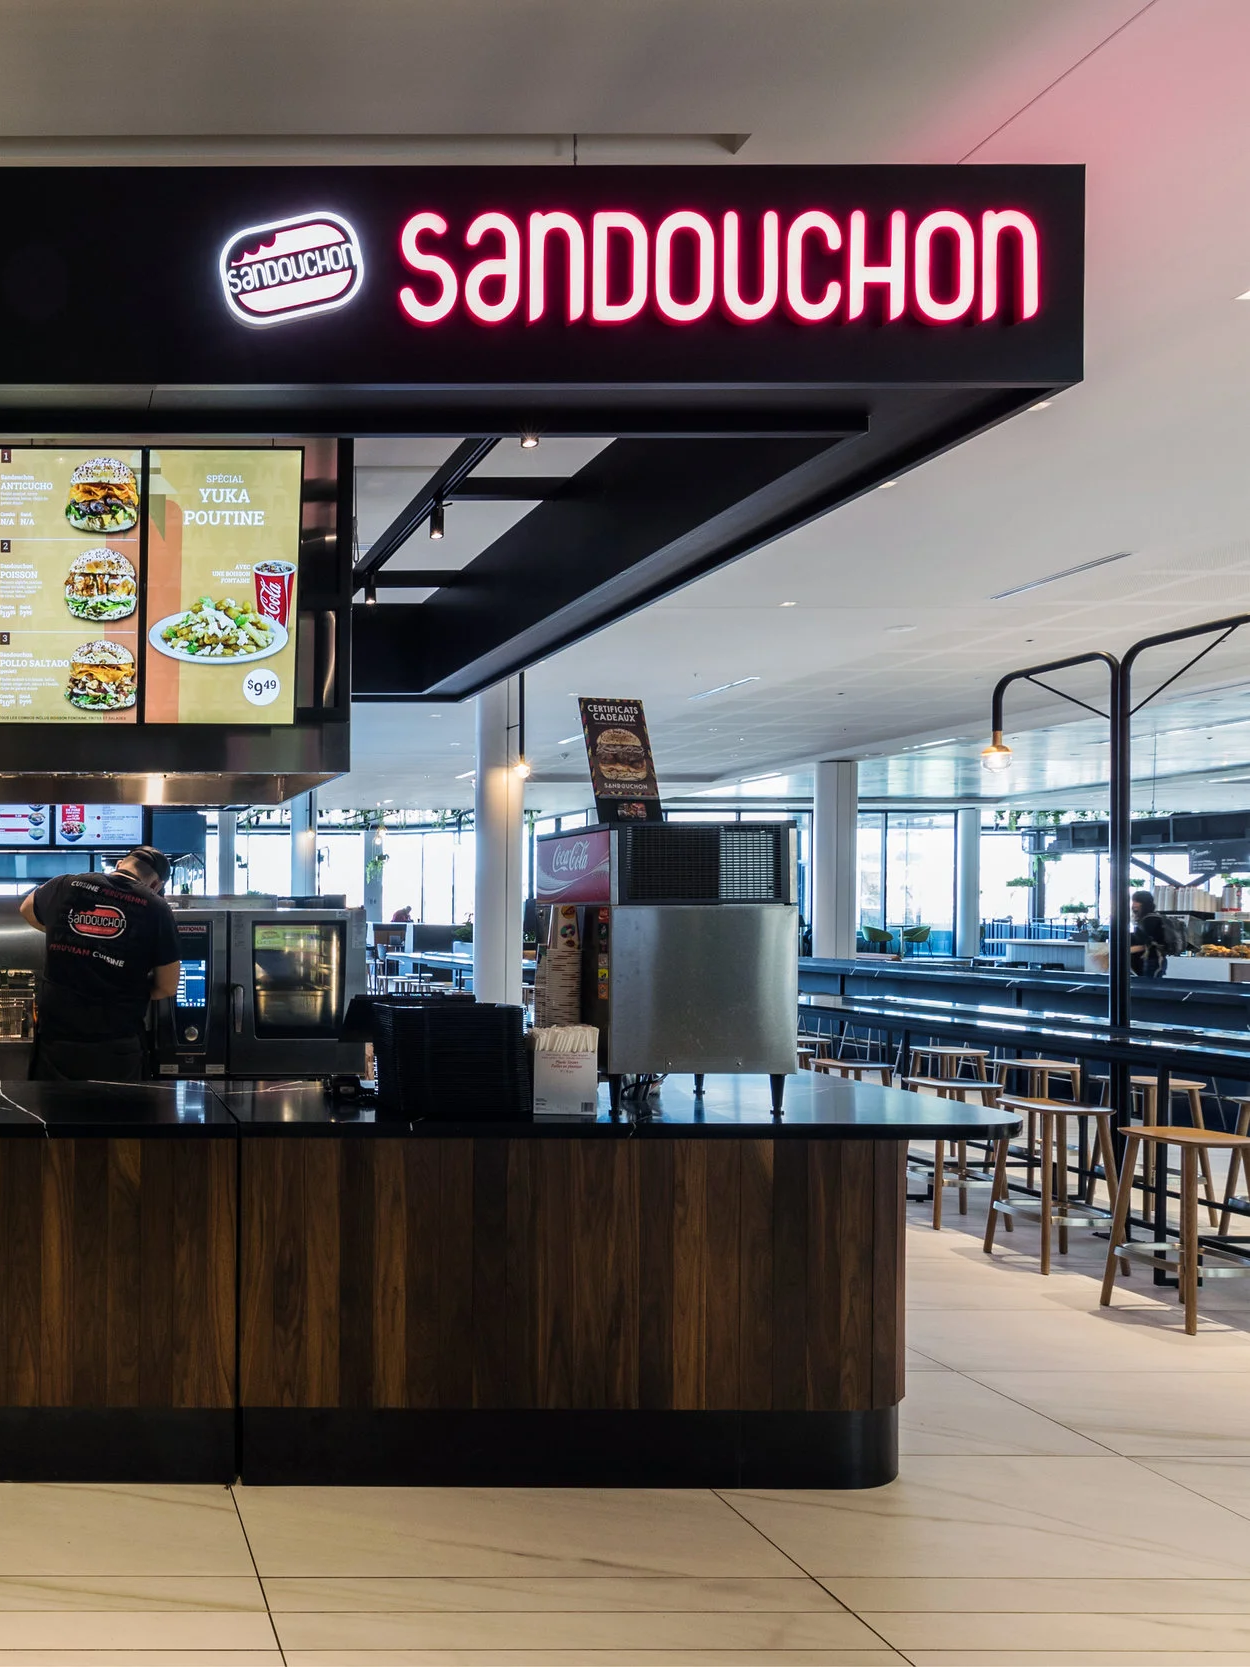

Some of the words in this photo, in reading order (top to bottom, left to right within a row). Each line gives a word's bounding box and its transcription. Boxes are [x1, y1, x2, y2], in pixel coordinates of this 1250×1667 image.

[3, 452, 9, 460] 1
[206, 473, 244, 484] SPÉCIAL
[0, 482, 53, 490] ANTICUCHO
[199, 488, 250, 503] YUKA
[0, 518, 15, 526] N/A
[20, 518, 35, 526] N/A
[183, 510, 265, 526] POUTINE
[2, 542, 8, 550] 2
[0, 570, 38, 579] POISSON
[0, 659, 27, 667] POLLO
[29, 659, 69, 667] SALTADO
[587, 704, 639, 715] CERTIFICATS
[592, 712, 636, 723] CADEAUX
[604, 782, 648, 790] SANDOUCHON
[71, 880, 100, 893] CUISINE
[92, 951, 125, 968] CUISINE
